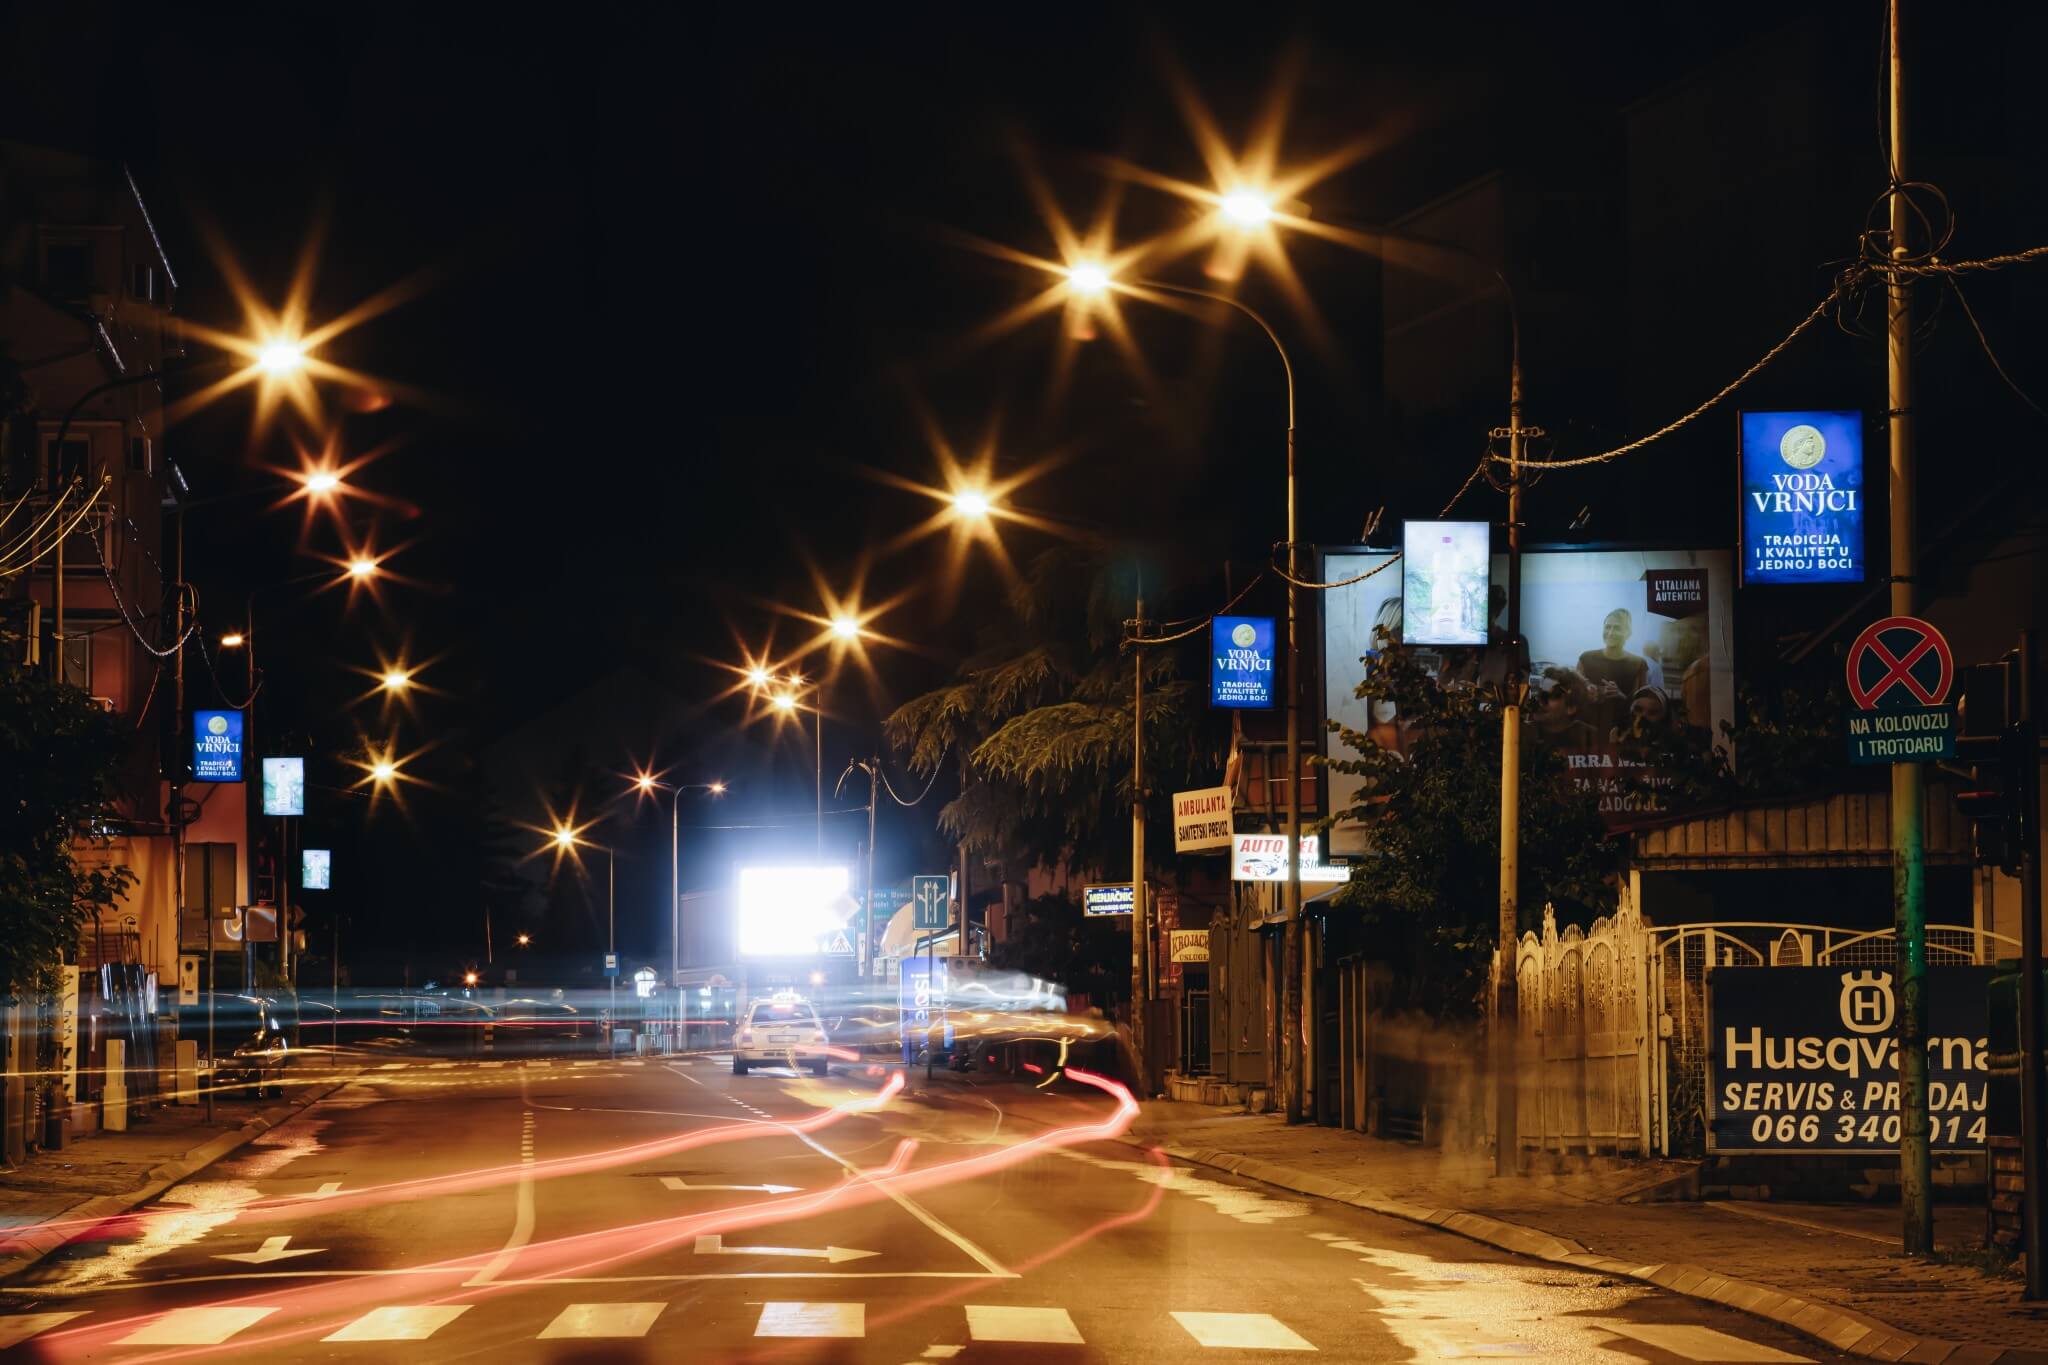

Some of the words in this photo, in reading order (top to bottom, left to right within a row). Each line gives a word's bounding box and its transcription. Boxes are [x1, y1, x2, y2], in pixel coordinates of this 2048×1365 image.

[1773, 473, 1835, 491] VODA
[1752, 490, 1857, 516] VRNJCI
[1763, 534, 1841, 546] TRADICIJA
[1756, 548, 1760, 559] I
[1765, 547, 1836, 559] KVALITET
[1839, 546, 1849, 558] U
[1757, 559, 1814, 571] JEDNOJ
[1818, 557, 1853, 570] BOCI
[1655, 579, 1701, 591] L'ITALIANA
[1655, 591, 1701, 602] AUTENTICA
[1228, 649, 1260, 661] VODA
[1217, 658, 1271, 673] VRNJCI
[1222, 681, 1262, 689] TRADICIJA
[1217, 694, 1248, 702] JEDNOJ
[1249, 694, 1268, 702] BOCI
[1850, 719, 1870, 735] NA
[1875, 712, 1950, 734] KOLOVOZU
[205, 735, 230, 743] VODA
[196, 743, 239, 753] VRNJCI
[1859, 740, 1864, 757] I
[1868, 736, 1944, 757] TROTOARU
[1178, 795, 1226, 817] AMBULANTA
[1178, 823, 1207, 842] SANITETSKI
[1208, 820, 1228, 839] PREVOZ
[1240, 839, 1284, 853] AUTO
[1723, 1082, 1835, 1111] SERVIS
[1840, 1089, 1856, 1110] &
[1863, 1081, 1988, 1111] PRDAJ
[1751, 1114, 1820, 1143] 066
[1834, 1114, 1901, 1143] 340
